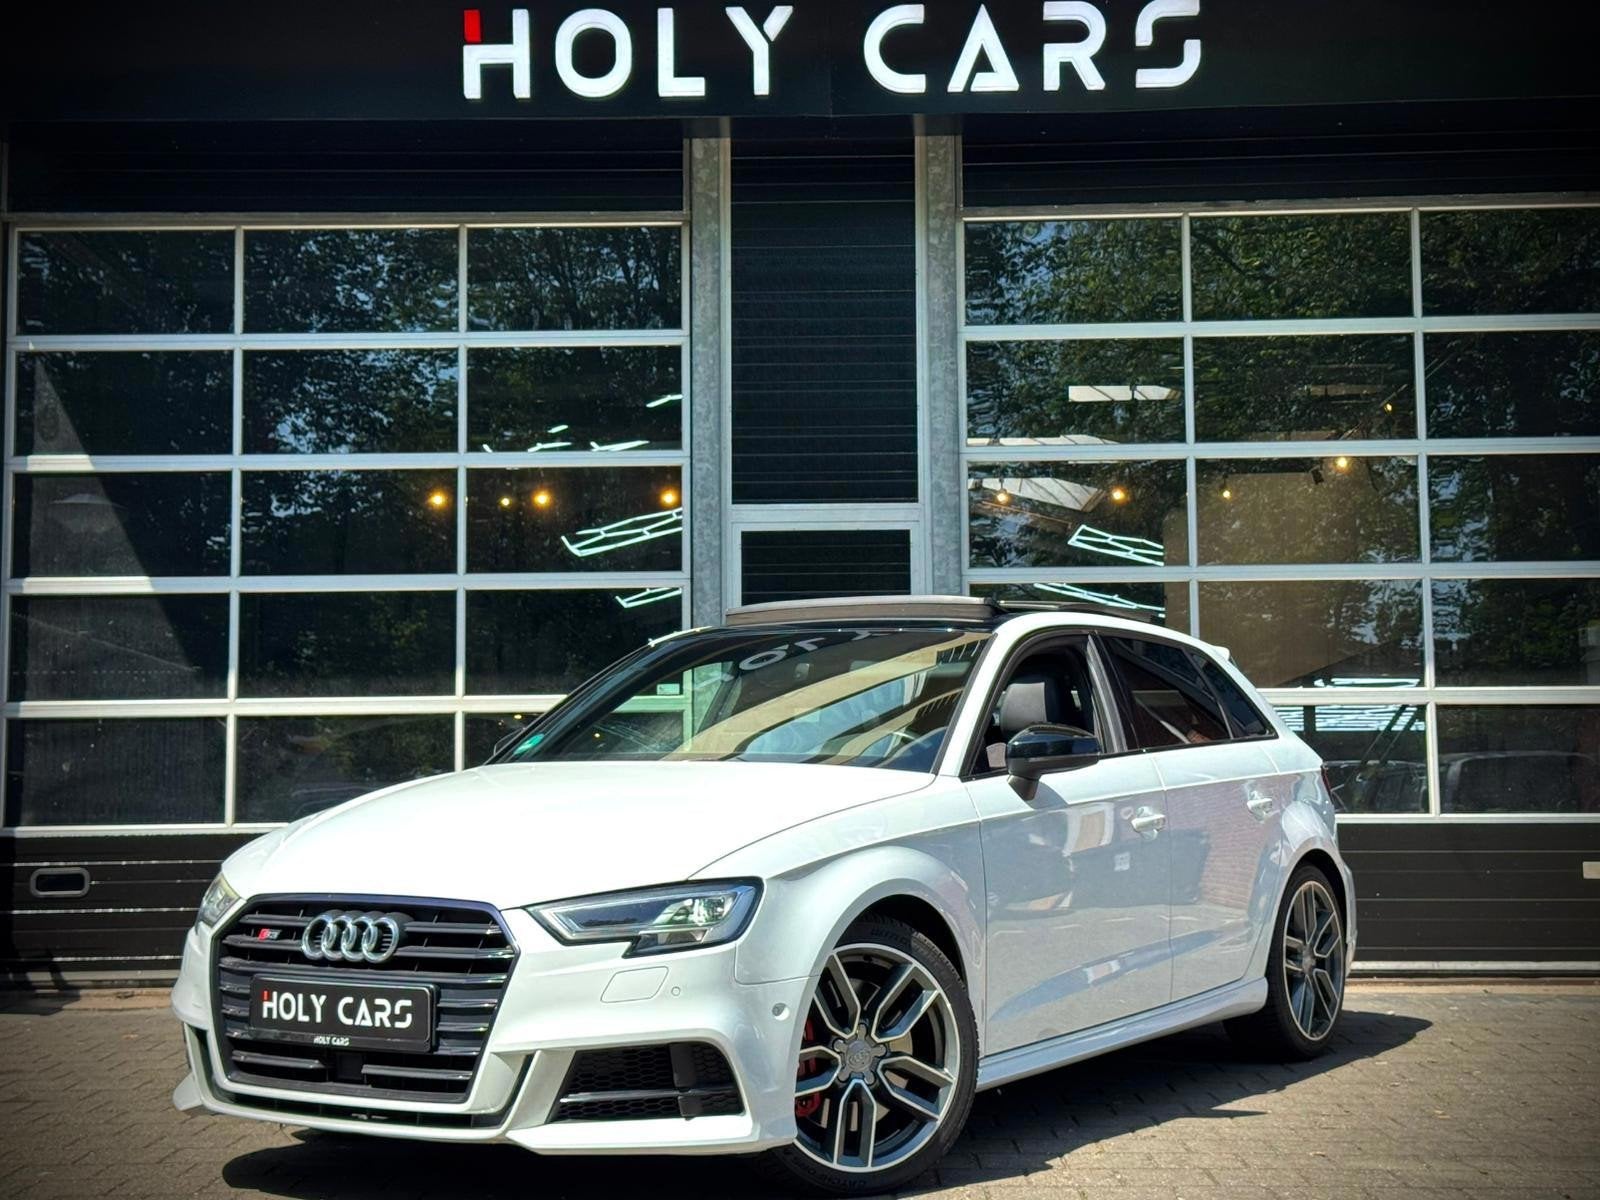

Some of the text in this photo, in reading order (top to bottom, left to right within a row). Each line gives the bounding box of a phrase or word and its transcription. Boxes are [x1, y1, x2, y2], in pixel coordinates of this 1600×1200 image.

[462, 0, 1203, 100] HOLY CARS
[262, 989, 413, 1029] HOLY CARS
[313, 1035, 350, 1047] HOLY CARS
